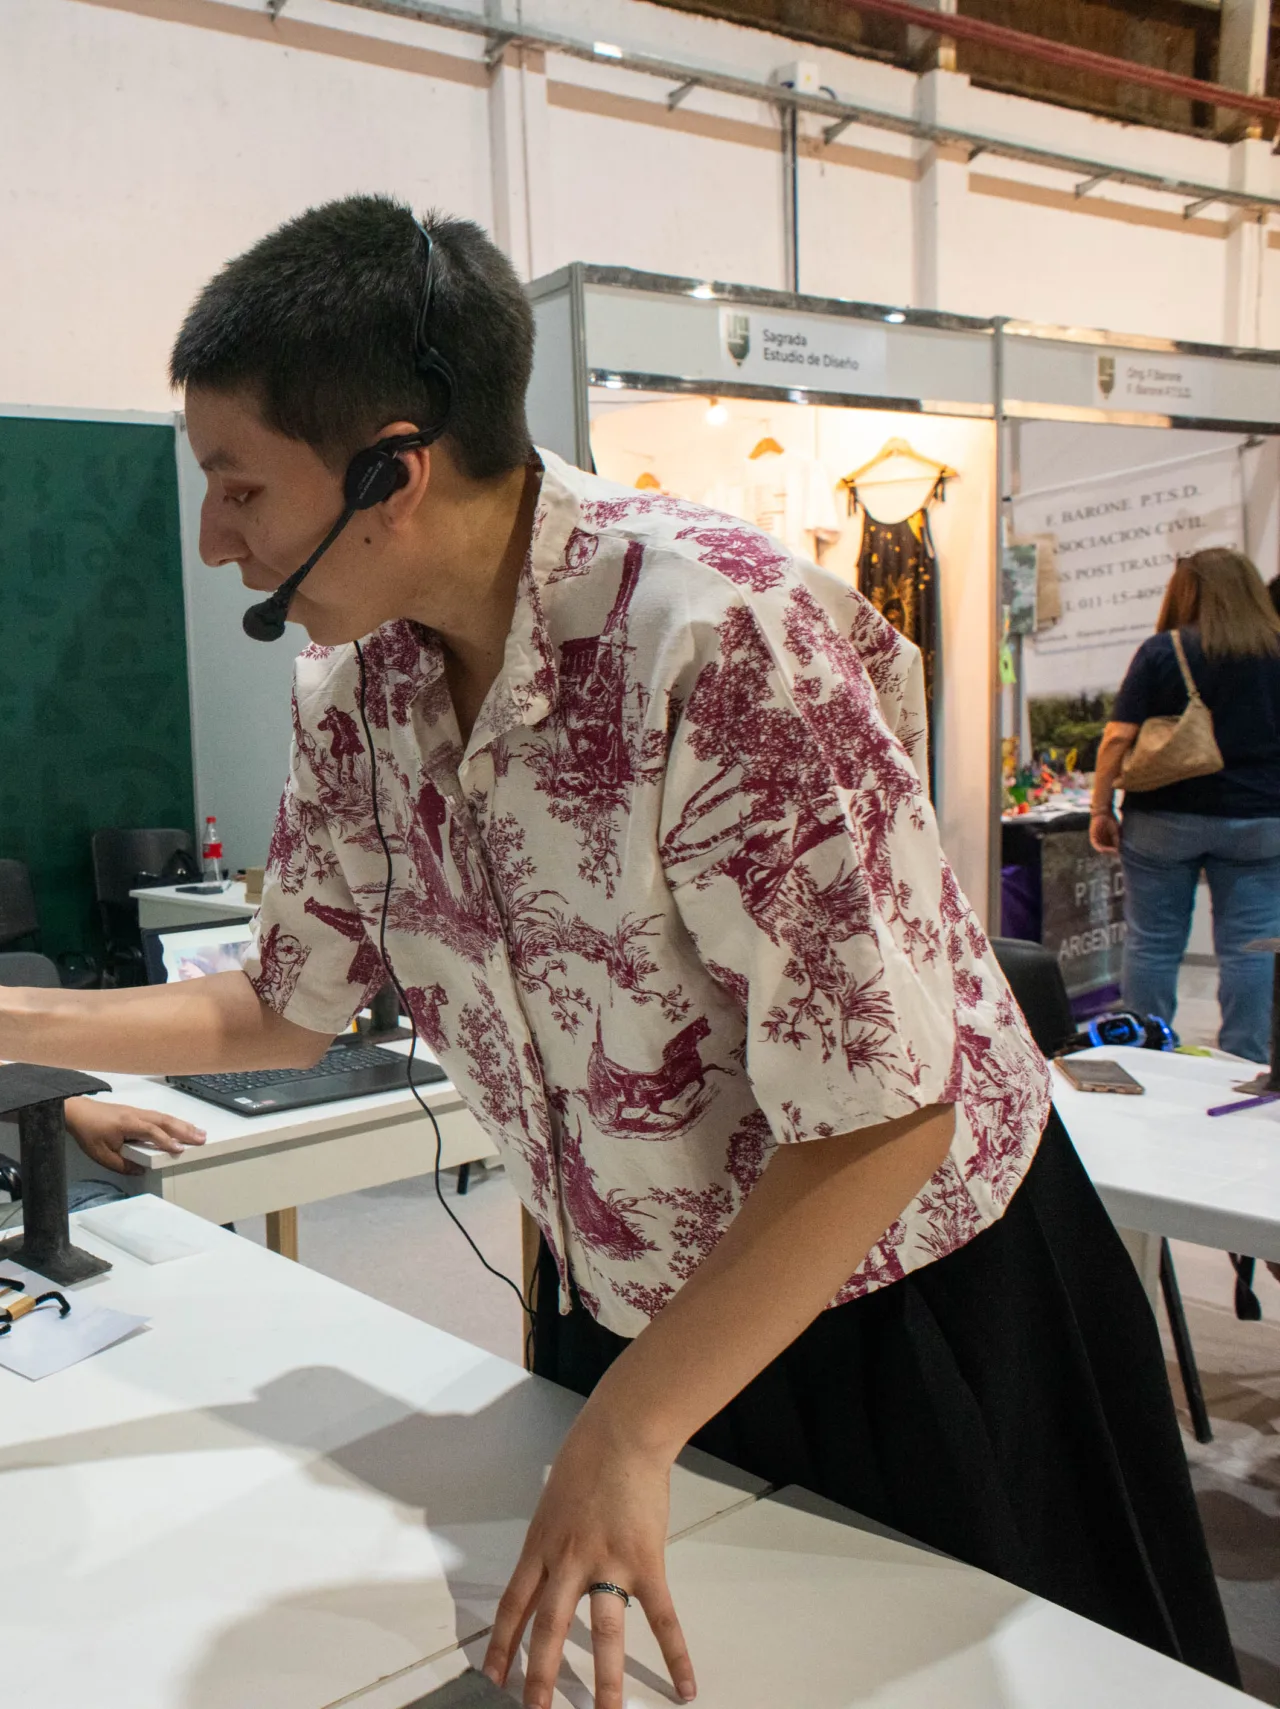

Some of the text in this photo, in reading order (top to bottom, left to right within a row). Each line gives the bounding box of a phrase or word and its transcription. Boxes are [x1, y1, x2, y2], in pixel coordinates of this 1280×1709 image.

[763, 328, 807, 347] Sagrada
[763, 347, 859, 371] Estudio de Diseño
[1061, 499, 1132, 524] BARONE
[1053, 525, 1151, 555] SOCIACION
